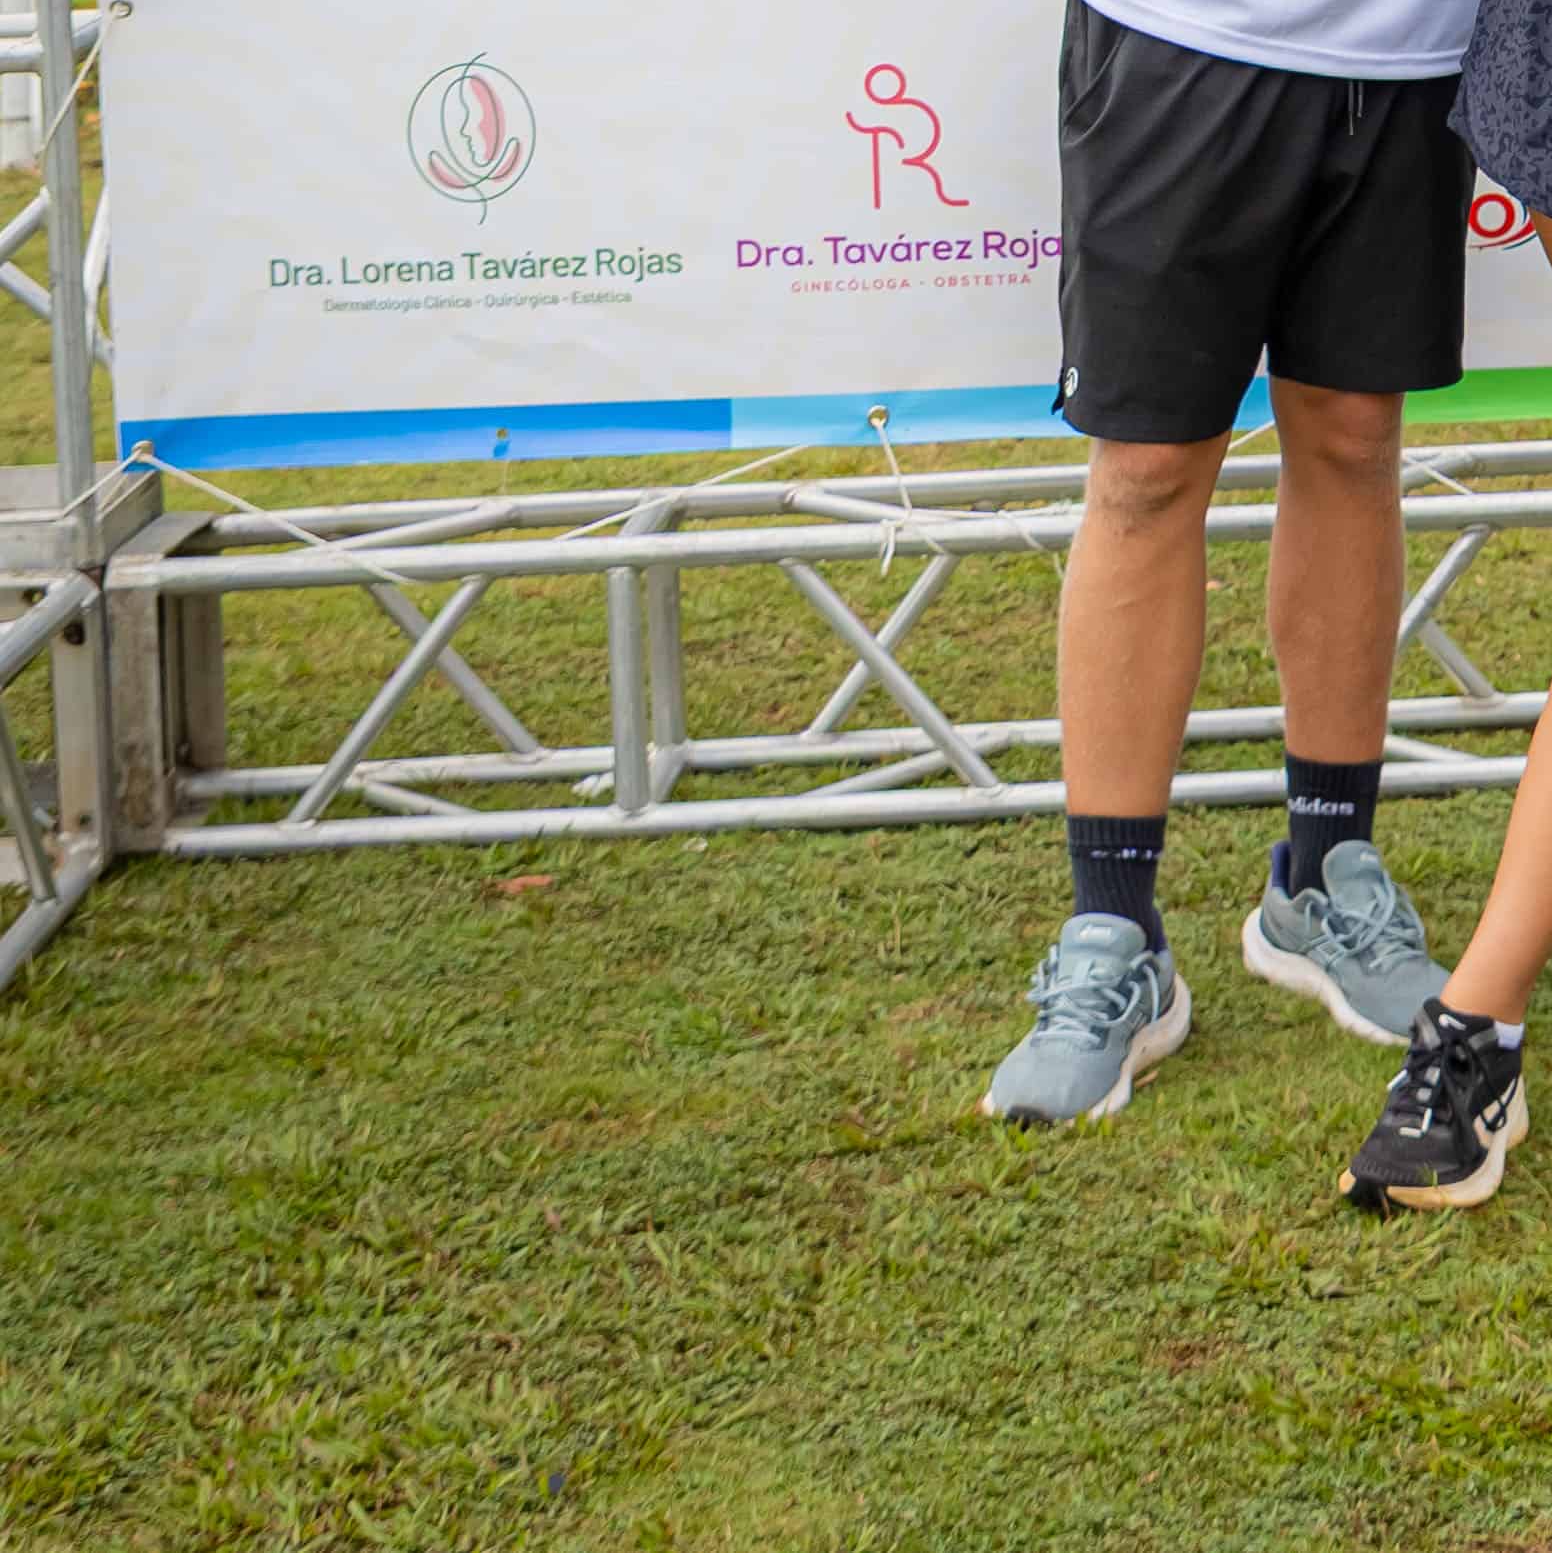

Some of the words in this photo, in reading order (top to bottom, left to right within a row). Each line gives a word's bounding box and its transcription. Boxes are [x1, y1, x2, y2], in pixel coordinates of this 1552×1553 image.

[269, 258, 333, 288] Dra.
[341, 255, 454, 285] Lorena
[461, 250, 587, 281] Tavárez
[594, 246, 684, 282] Rojas
[736, 239, 814, 269] Dra.
[823, 234, 973, 266] Tavárez
[791, 277, 912, 294] GINECÓLOGA
[933, 273, 1033, 289] OBSTETRA
